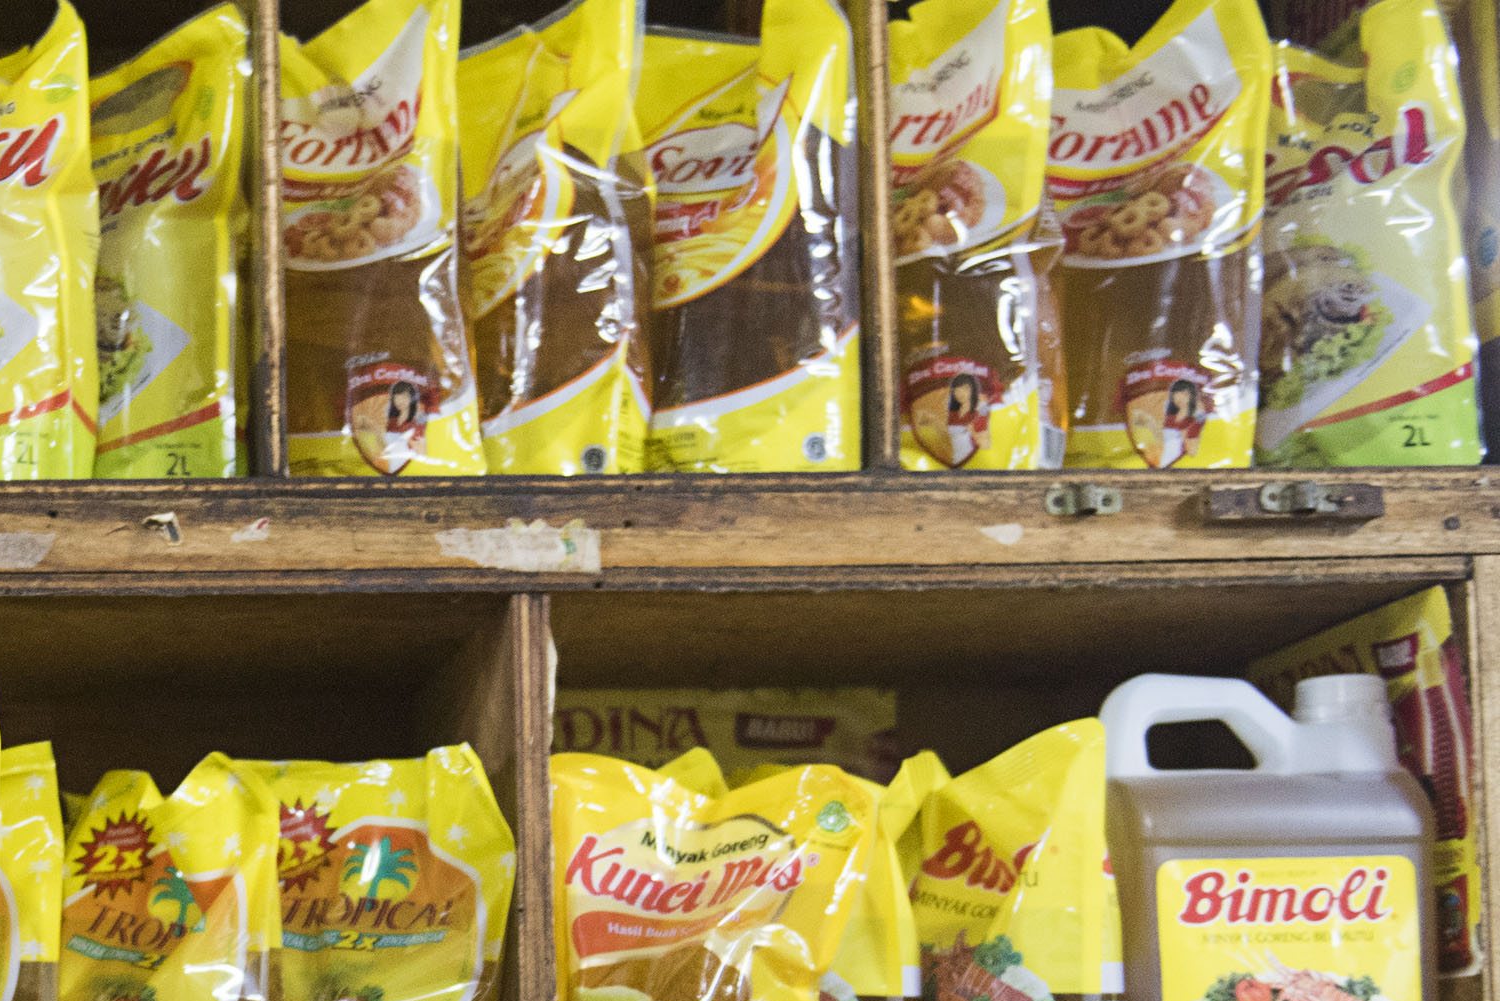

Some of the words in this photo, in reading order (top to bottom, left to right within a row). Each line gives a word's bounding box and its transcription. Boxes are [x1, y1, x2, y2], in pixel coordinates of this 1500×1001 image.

[1403, 424, 1431, 448] 2L
[166, 452, 192, 476] 2L
[92, 844, 145, 873] 2x
[564, 835, 711, 914] Kunci
[1179, 868, 1391, 925] Bimoli
[334, 929, 379, 951] 2x
